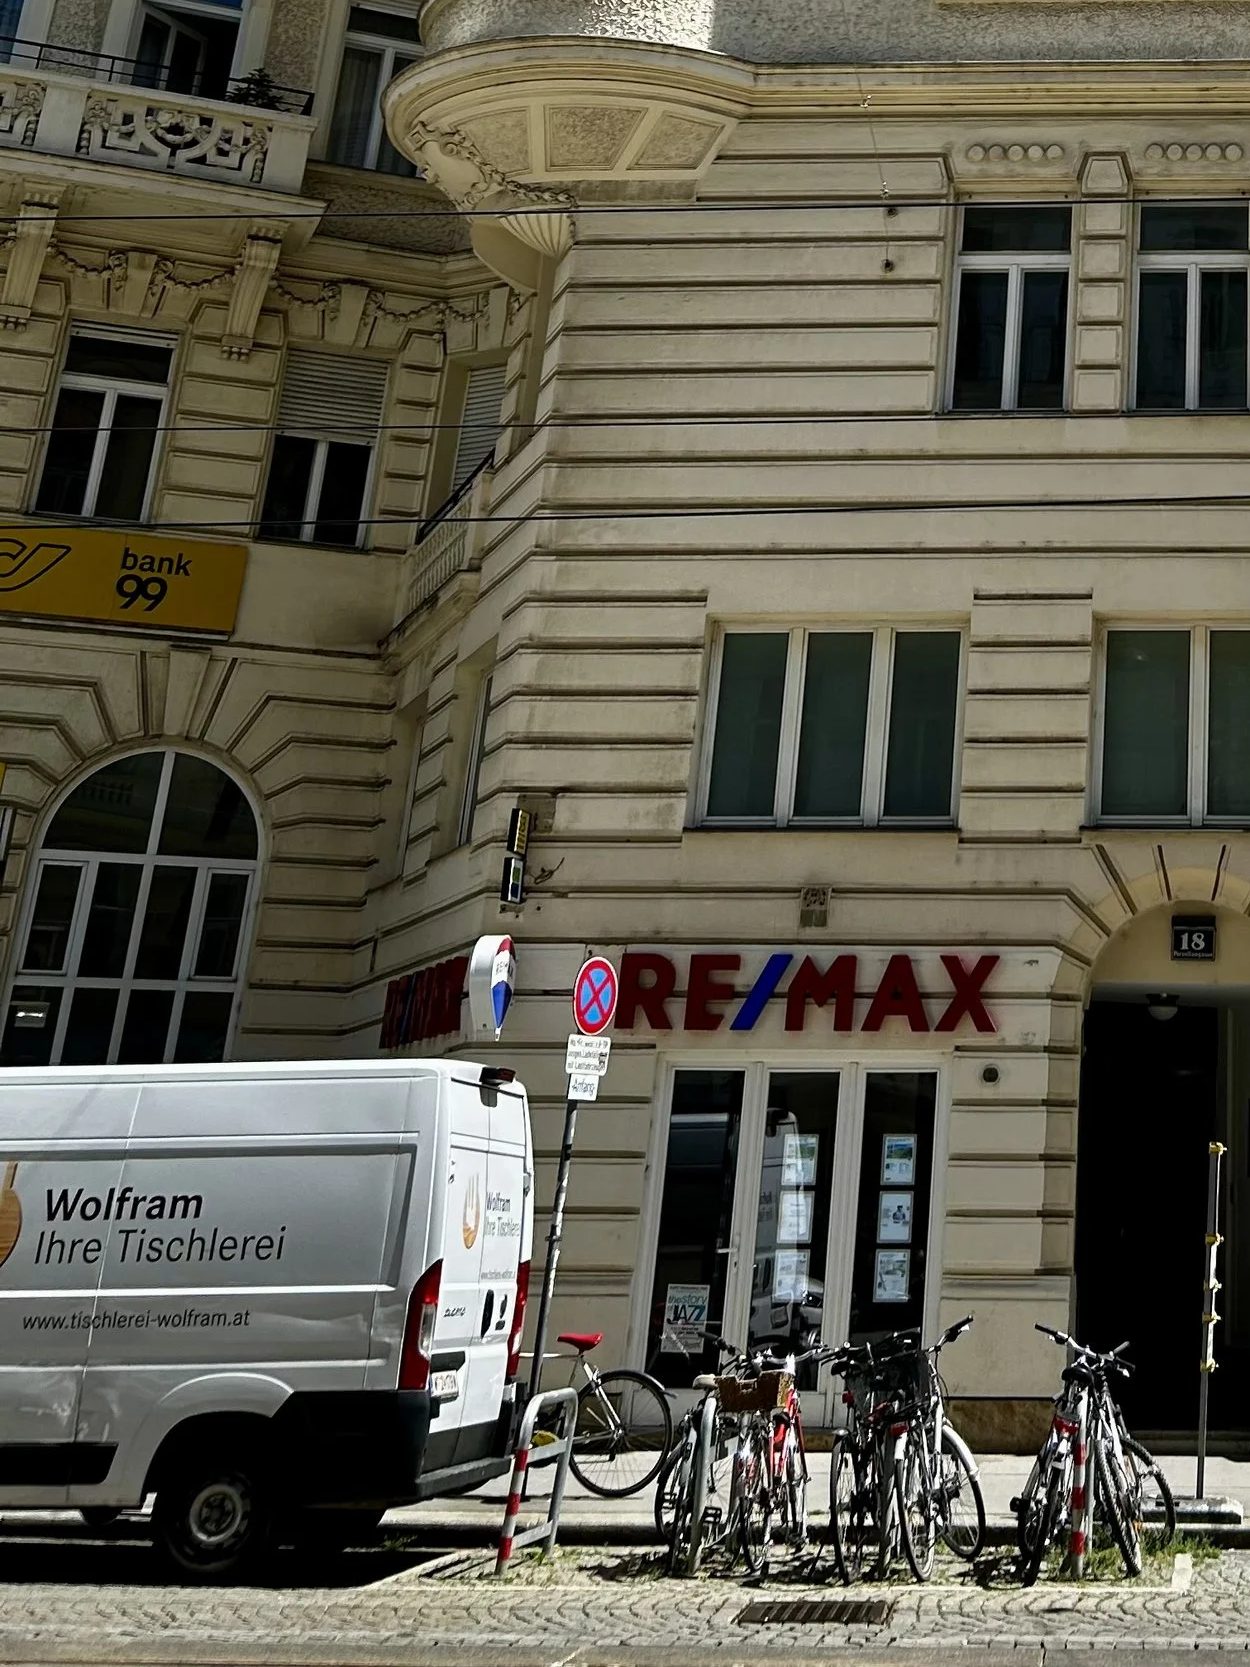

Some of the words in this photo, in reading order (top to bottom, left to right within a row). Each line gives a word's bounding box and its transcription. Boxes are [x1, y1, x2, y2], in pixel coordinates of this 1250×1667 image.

[121, 547, 193, 577] bank
[116, 573, 168, 612] 99
[1180, 932, 1206, 951] 18
[614, 952, 1000, 1033] RE/MAX
[46, 1186, 204, 1222] Wolfram
[486, 1191, 511, 1212] Wolfram
[34, 1229, 102, 1265] Ihre
[118, 1225, 287, 1263] Tischlerei
[22, 1309, 251, 1331] www.tischlerei-wolfram.at
[666, 1304, 706, 1325] JAZZ
